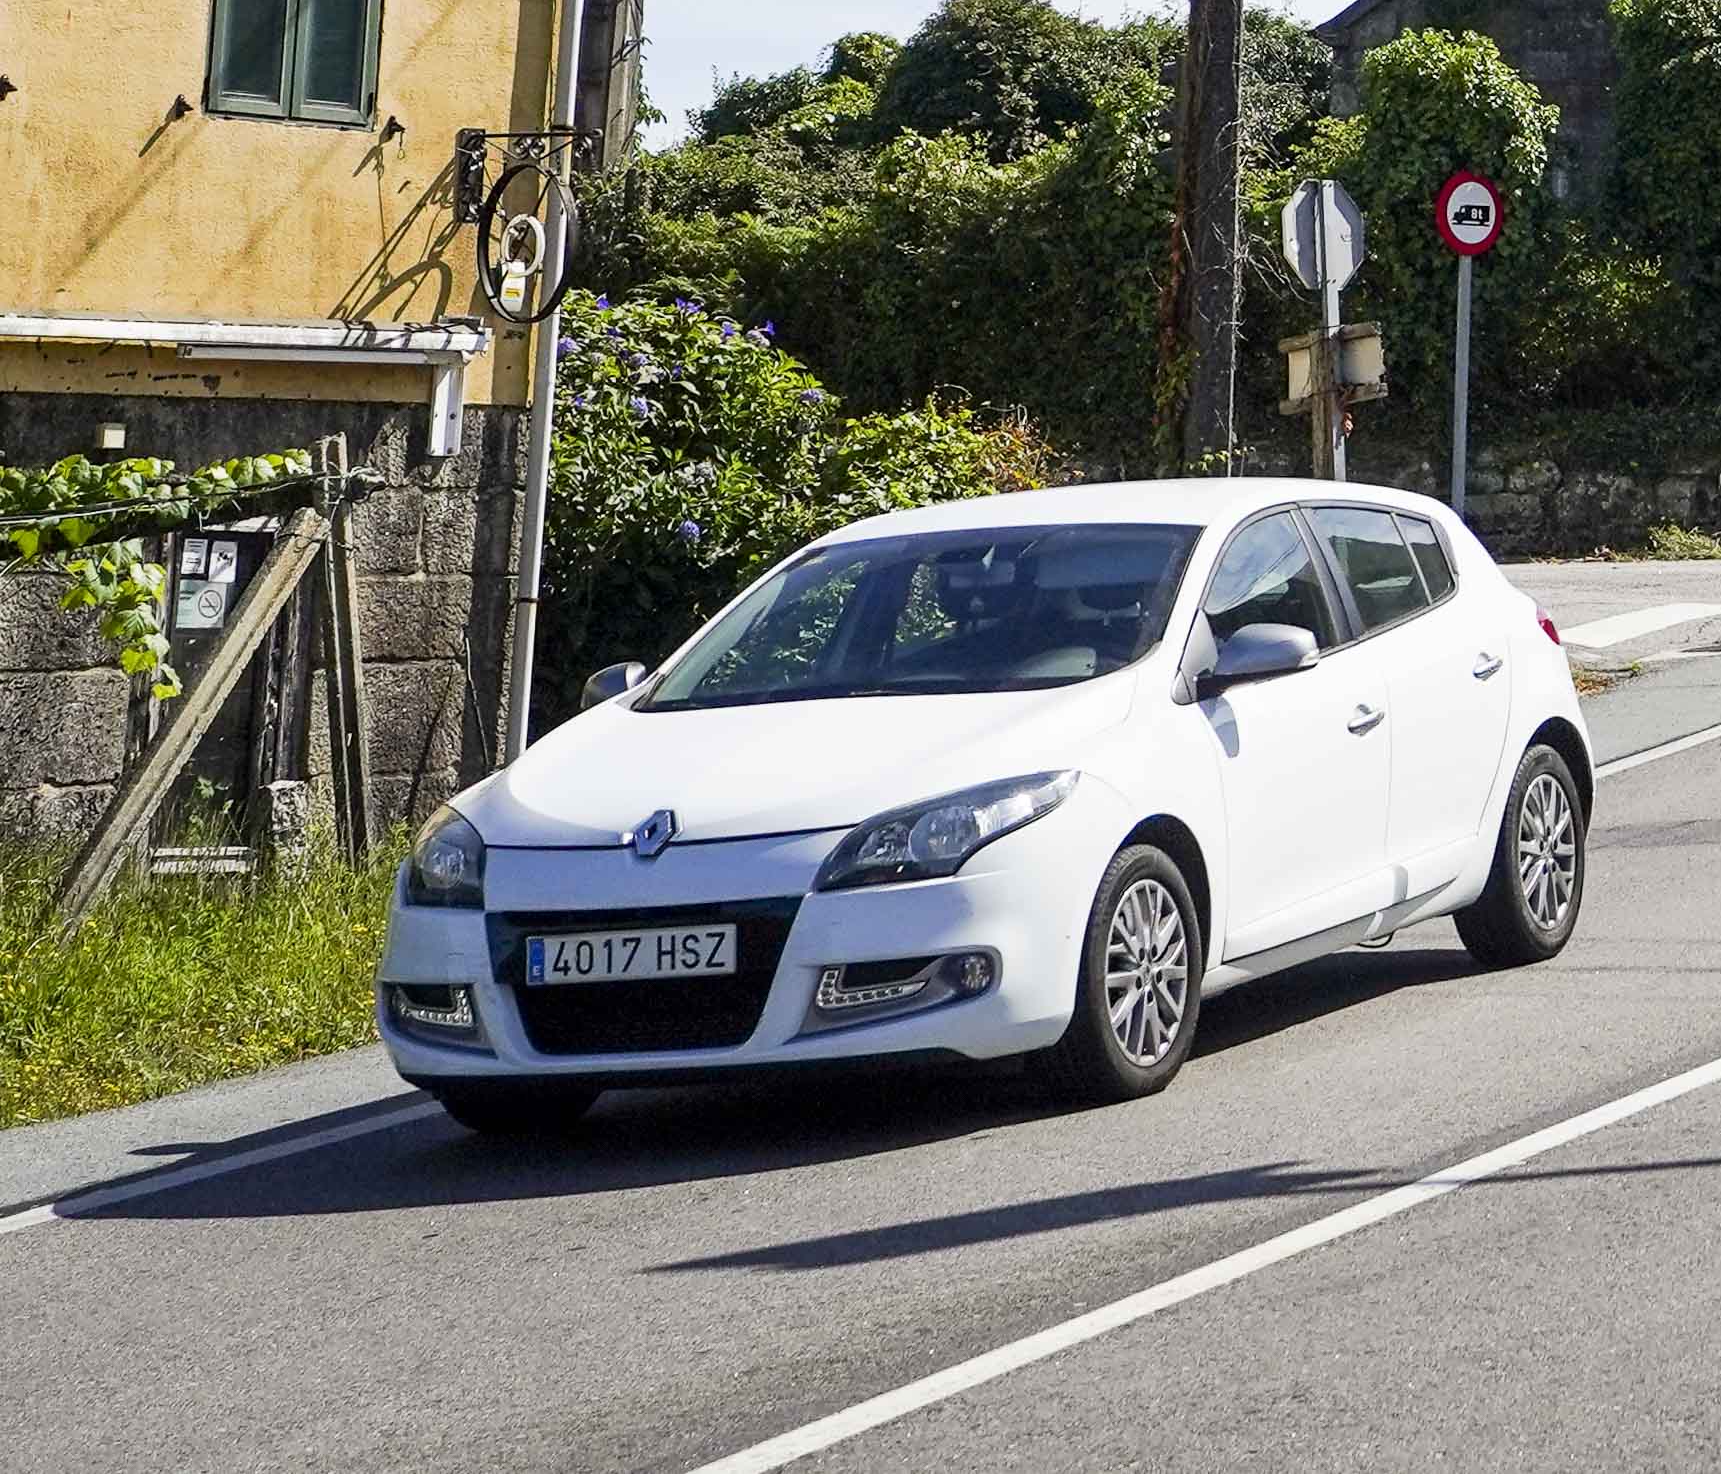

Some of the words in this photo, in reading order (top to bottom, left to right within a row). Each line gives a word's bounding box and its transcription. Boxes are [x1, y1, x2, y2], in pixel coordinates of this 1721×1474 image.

[532, 966, 542, 976] E
[553, 936, 642, 976] 4017
[656, 931, 726, 970] HSZ
